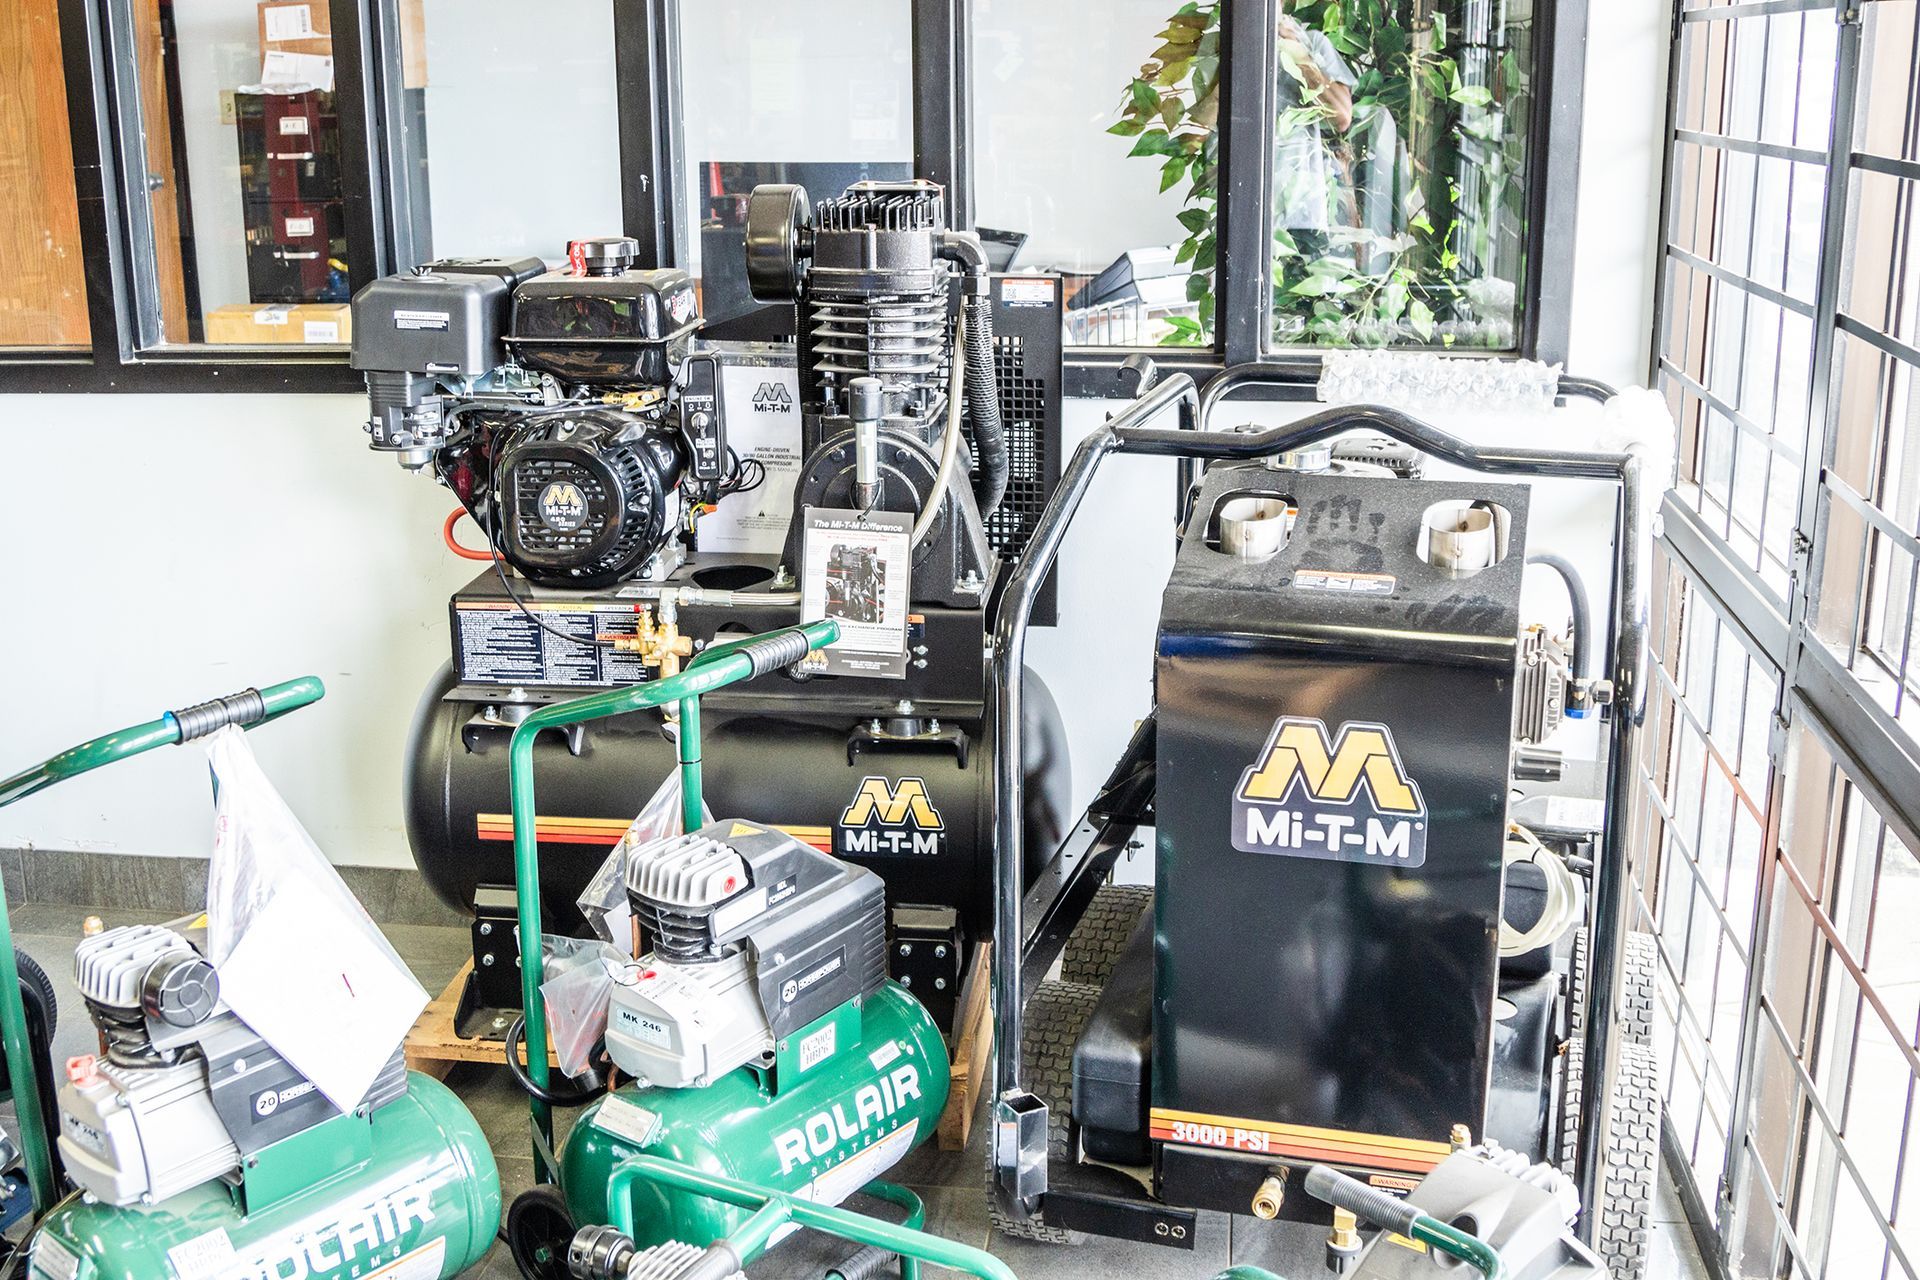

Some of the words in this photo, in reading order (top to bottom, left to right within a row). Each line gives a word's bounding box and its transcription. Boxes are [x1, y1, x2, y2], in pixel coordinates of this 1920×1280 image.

[754, 403, 791, 414] Mi-T-M
[814, 519, 830, 529] The
[831, 520, 860, 530] Mi-T-M
[861, 522, 904, 532] Difference
[845, 829, 938, 855] Mi-T-M
[1246, 806, 1411, 858] Mi-T-M
[622, 1011, 639, 1025] MK
[642, 1019, 662, 1033] 246
[801, 1028, 833, 1054] FC2002
[773, 1063, 923, 1176] ROLAIR
[810, 1118, 899, 1178] SYSTEMS
[1171, 1120, 1228, 1147] 3000
[1233, 1127, 1270, 1152] PSI
